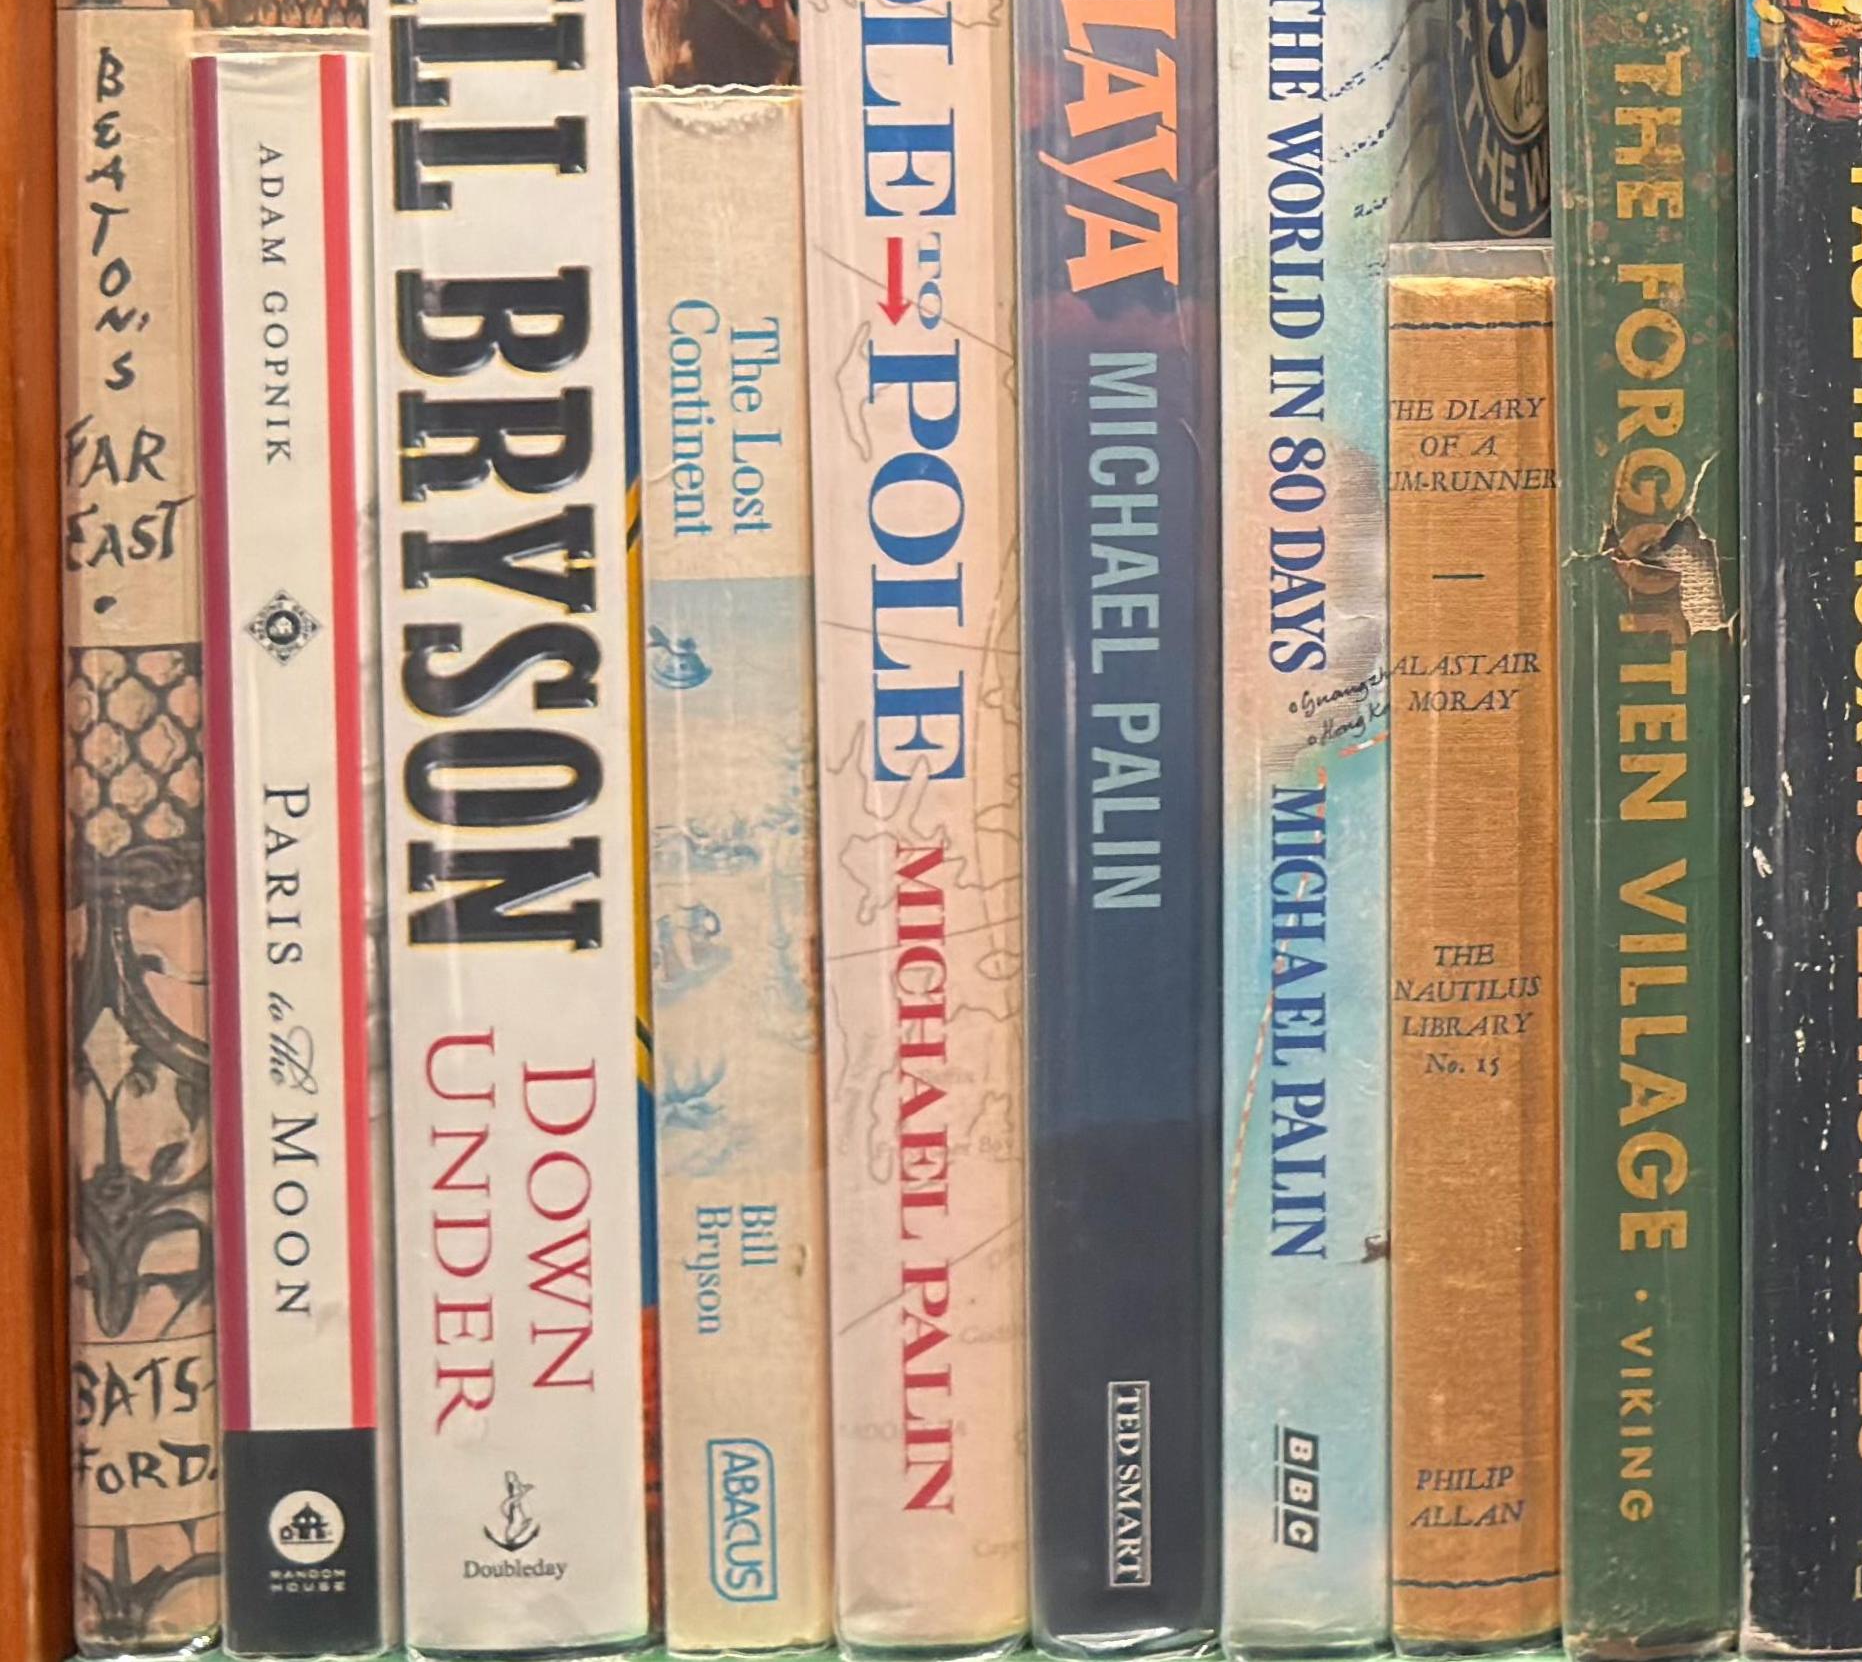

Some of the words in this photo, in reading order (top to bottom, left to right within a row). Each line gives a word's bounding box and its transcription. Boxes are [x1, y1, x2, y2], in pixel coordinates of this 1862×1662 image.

[1614, 49, 1686, 220] THE
[260, 143, 286, 266] ADAM
[1267, 113, 1326, 340] WORLD
[916, 232, 943, 330] TO
[262, 291, 291, 466] GOPNIK
[667, 299, 721, 539] Continent
[730, 316, 780, 413] The
[1268, 354, 1326, 422] IN
[1390, 399, 1434, 421] HE
[1446, 397, 1546, 421] DIARY
[65, 414, 167, 488] FAR
[731, 429, 782, 535] Lost
[1268, 435, 1327, 514] 80
[1420, 435, 1459, 457] OF
[1471, 435, 1498, 457] A
[66, 494, 196, 571] EAST
[867, 339, 966, 783] POLE
[1089, 352, 1160, 675] MICHAEL
[1614, 263, 1688, 821] FORGOTTEN
[396, 267, 604, 951] BRYSON
[1268, 527, 1328, 674] DAYS
[1391, 652, 1541, 676] ALASTAIR
[1408, 688, 1520, 712] MORAY
[1090, 702, 1162, 909] PALIN
[264, 784, 310, 966] PARIS
[1270, 784, 1328, 1071] MICHAEL
[268, 992, 294, 1022] to
[1394, 975, 1541, 1002] NAUTILUS
[1433, 943, 1495, 967] THE
[268, 1025, 318, 1095] the
[895, 843, 950, 1240] MICHAEL
[1402, 1012, 1533, 1037] LIBRARY
[1424, 1053, 1465, 1074] No.
[1476, 1056, 1500, 1076] 15
[1616, 858, 1689, 1252] VILLAGE
[271, 1113, 320, 1318] MOON
[522, 1058, 597, 1392] DOWN
[1270, 1079, 1328, 1260] PALIN
[425, 1026, 498, 1436] UNDER
[681, 1204, 734, 1336] Bryson
[740, 1204, 778, 1268] Bill
[900, 1259, 955, 1514] PALIN
[1115, 1388, 1140, 1456] TED
[1619, 1326, 1655, 1523] VIKING
[720, 1450, 763, 1592] ABACUS
[1115, 1461, 1142, 1583] SMART
[1284, 1429, 1318, 1550] BBC
[1410, 1499, 1524, 1528] ALLAN
[1416, 1465, 1514, 1491] PHILIP
[270, 1569, 346, 1579] RANDOM
[270, 1581, 346, 1593] HOUSE
[463, 1559, 568, 1582] Doubleday
